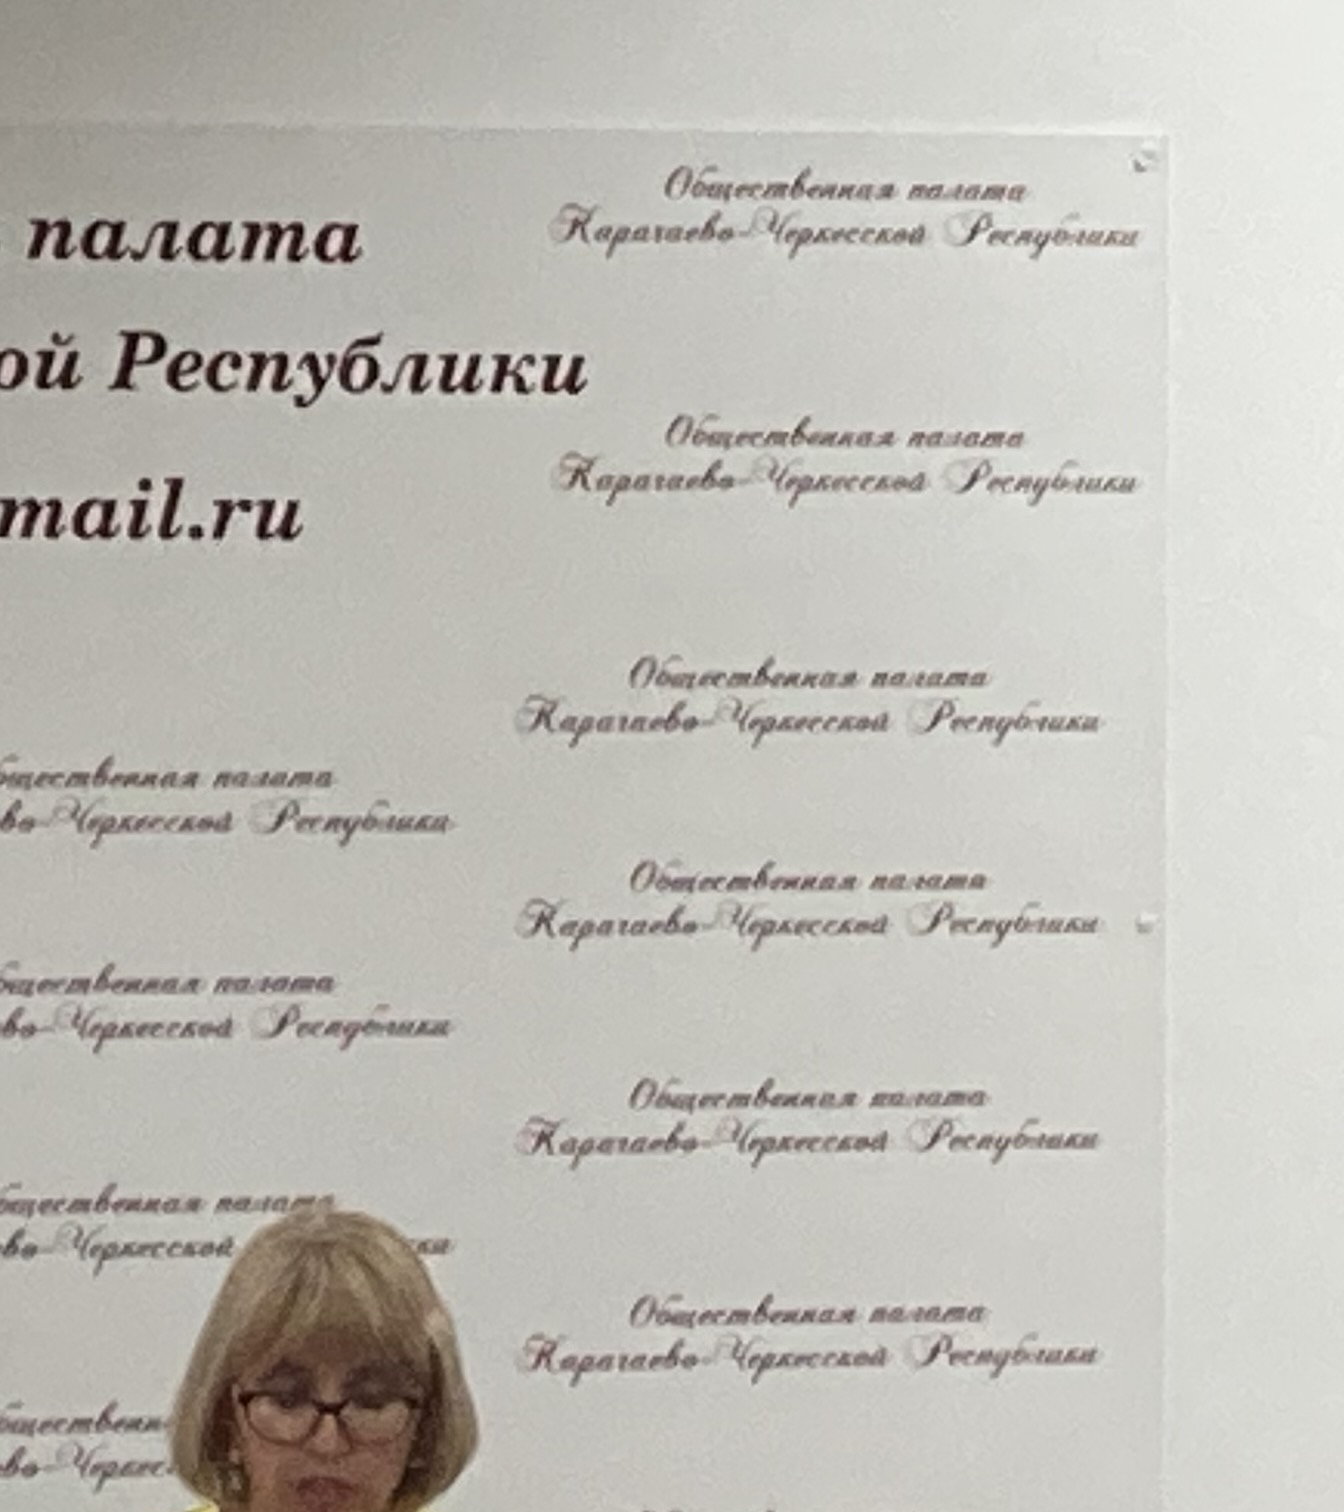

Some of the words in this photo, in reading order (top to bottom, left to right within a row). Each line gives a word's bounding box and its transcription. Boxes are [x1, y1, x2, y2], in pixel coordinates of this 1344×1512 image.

[664, 165, 898, 203] Общественная
[907, 183, 1029, 203] палата
[27, 218, 363, 264] палата
[556, 202, 927, 260] Карачаево-Черкесской
[952, 212, 1140, 261] Республики
[108, 330, 588, 409] Республики
[665, 413, 898, 451] Общественная
[907, 431, 1025, 449] палата
[559, 451, 930, 509] Карачаево-Черкесской
[949, 459, 1138, 507] Республики
[629, 655, 860, 691] Общественная
[870, 671, 989, 688] палата
[517, 693, 890, 749] Карачаево-Черкесской
[913, 699, 1100, 747] Республики
[212, 771, 337, 789] палата
[254, 799, 455, 848] Республики
[630, 859, 858, 894] Общественная
[869, 874, 988, 891] палата
[520, 898, 889, 952] Карачаево-Черкесской
[911, 901, 1099, 949] Республики
[213, 976, 336, 994] палата
[257, 1003, 454, 1051] Республики
[628, 1077, 858, 1115] Общественная
[869, 1090, 990, 1108] палата
[517, 1116, 889, 1171] Карачаево-Черкесской
[915, 1117, 1101, 1165] Республики
[629, 1293, 860, 1330] Общественная
[868, 1305, 987, 1324] палата
[517, 1333, 889, 1388] Карачаево-Черкесской
[914, 1332, 1098, 1379] Республики
